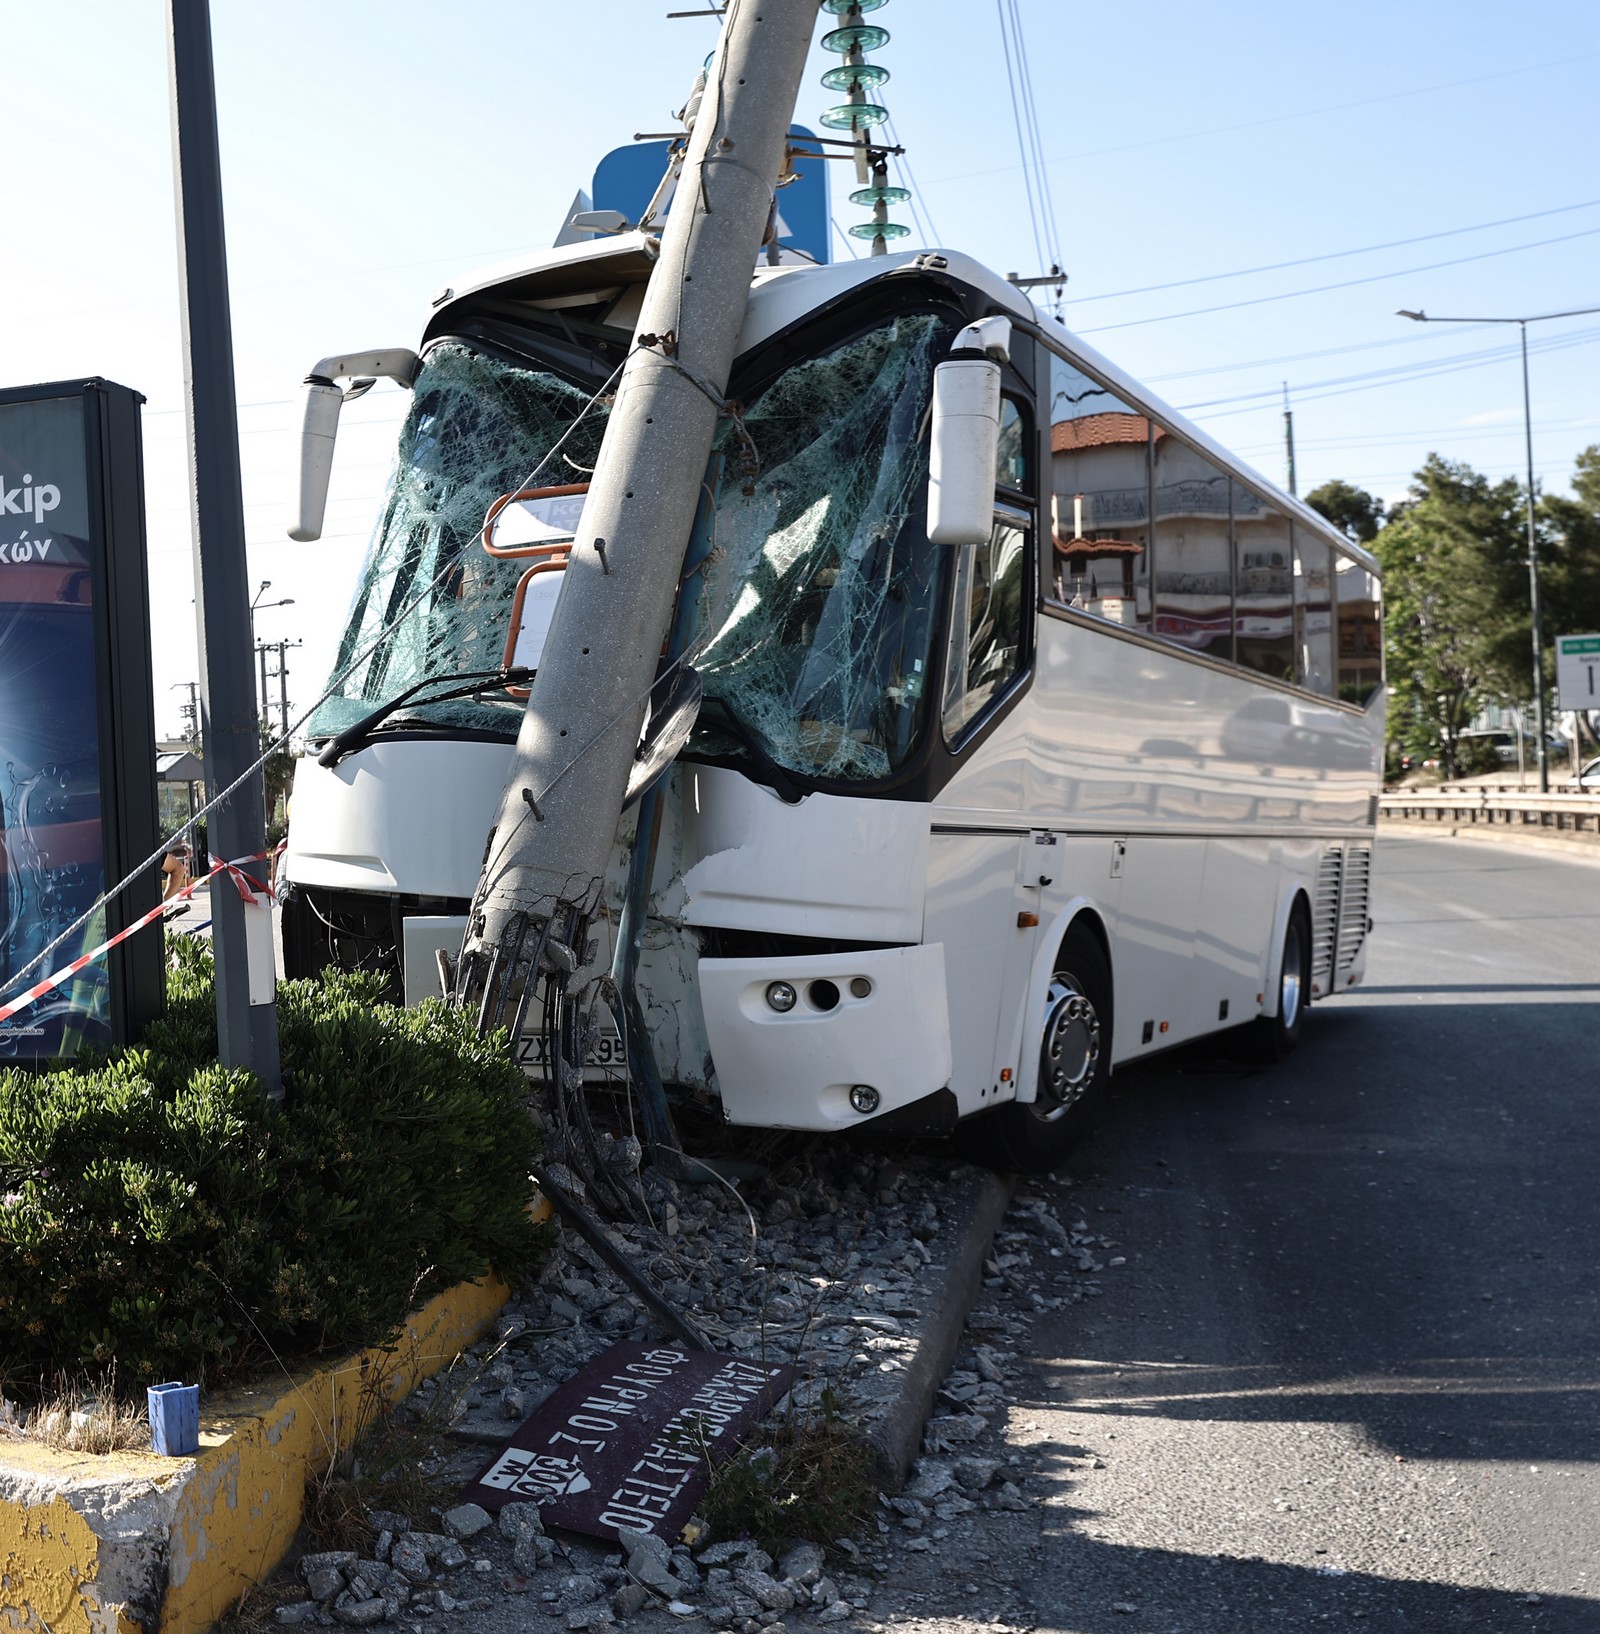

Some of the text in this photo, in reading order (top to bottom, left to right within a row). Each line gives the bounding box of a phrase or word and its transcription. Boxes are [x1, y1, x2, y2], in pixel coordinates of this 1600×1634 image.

[0, 473, 61, 524] kip
[586, 1038, 627, 1063] 95
[548, 1349, 690, 1454] ΦΟΥΡΝΟΣ
